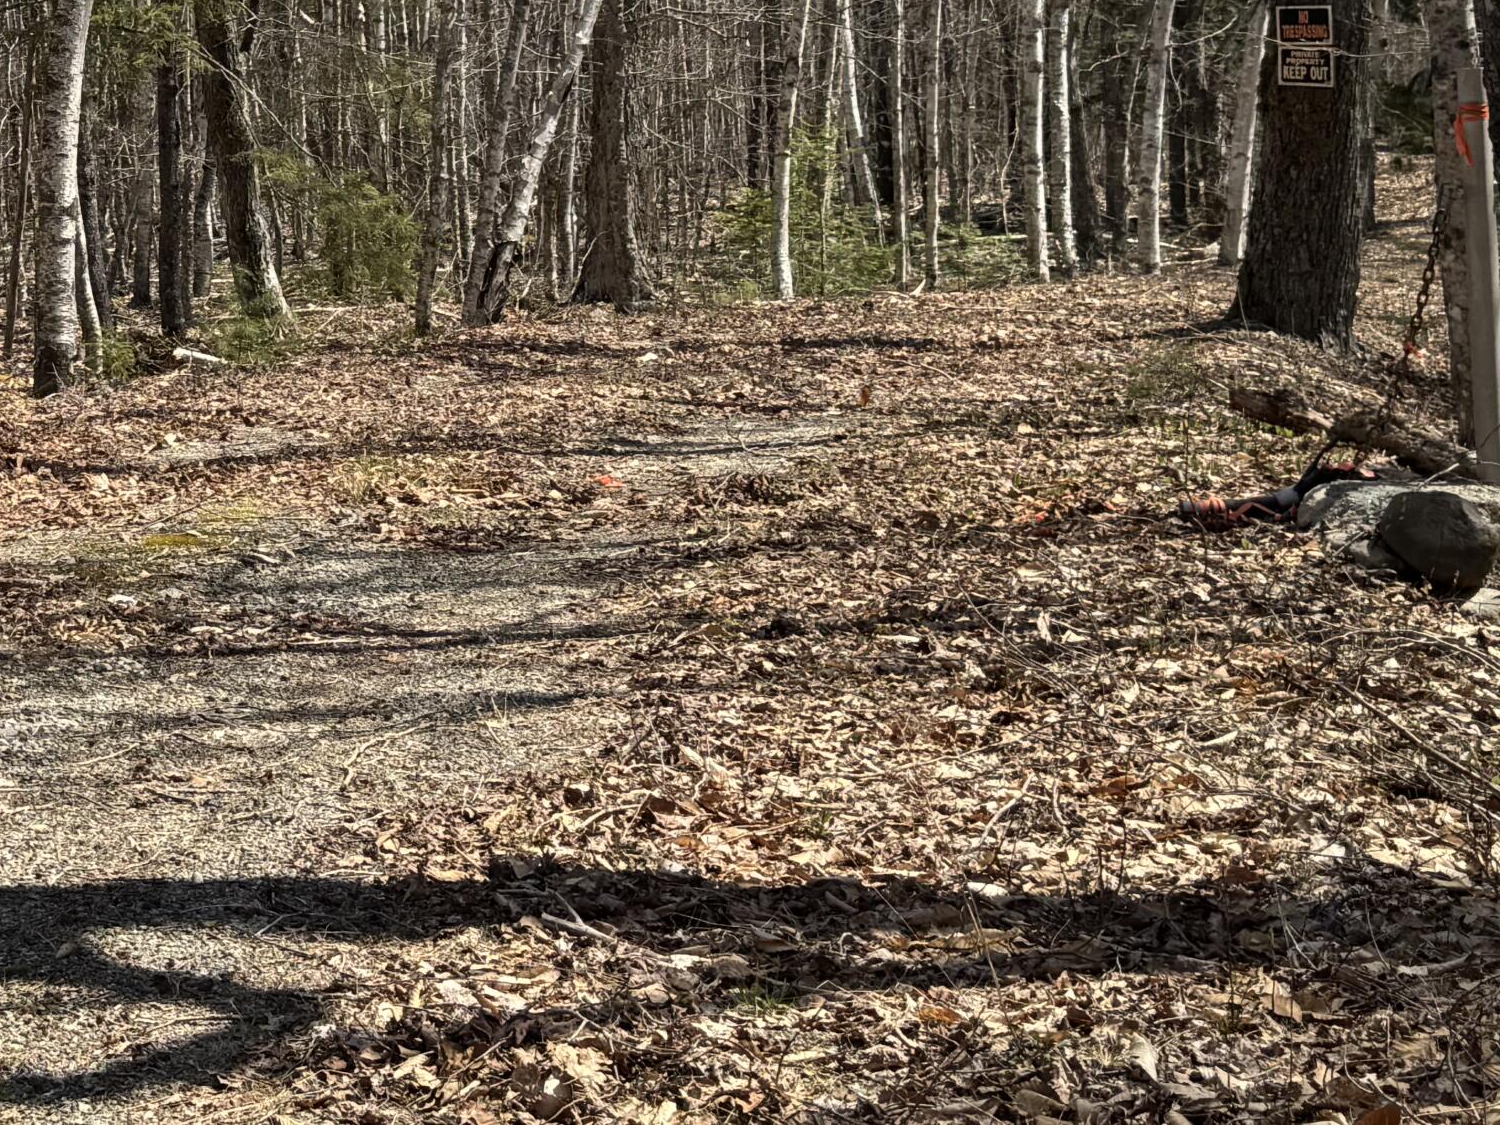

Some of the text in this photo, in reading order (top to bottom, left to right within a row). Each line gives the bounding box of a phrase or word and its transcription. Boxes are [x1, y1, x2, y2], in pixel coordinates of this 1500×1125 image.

[1298, 10, 1309, 24] NO
[1282, 24, 1328, 39] TRESPASSING
[1283, 66, 1329, 81] KEEP OUT
